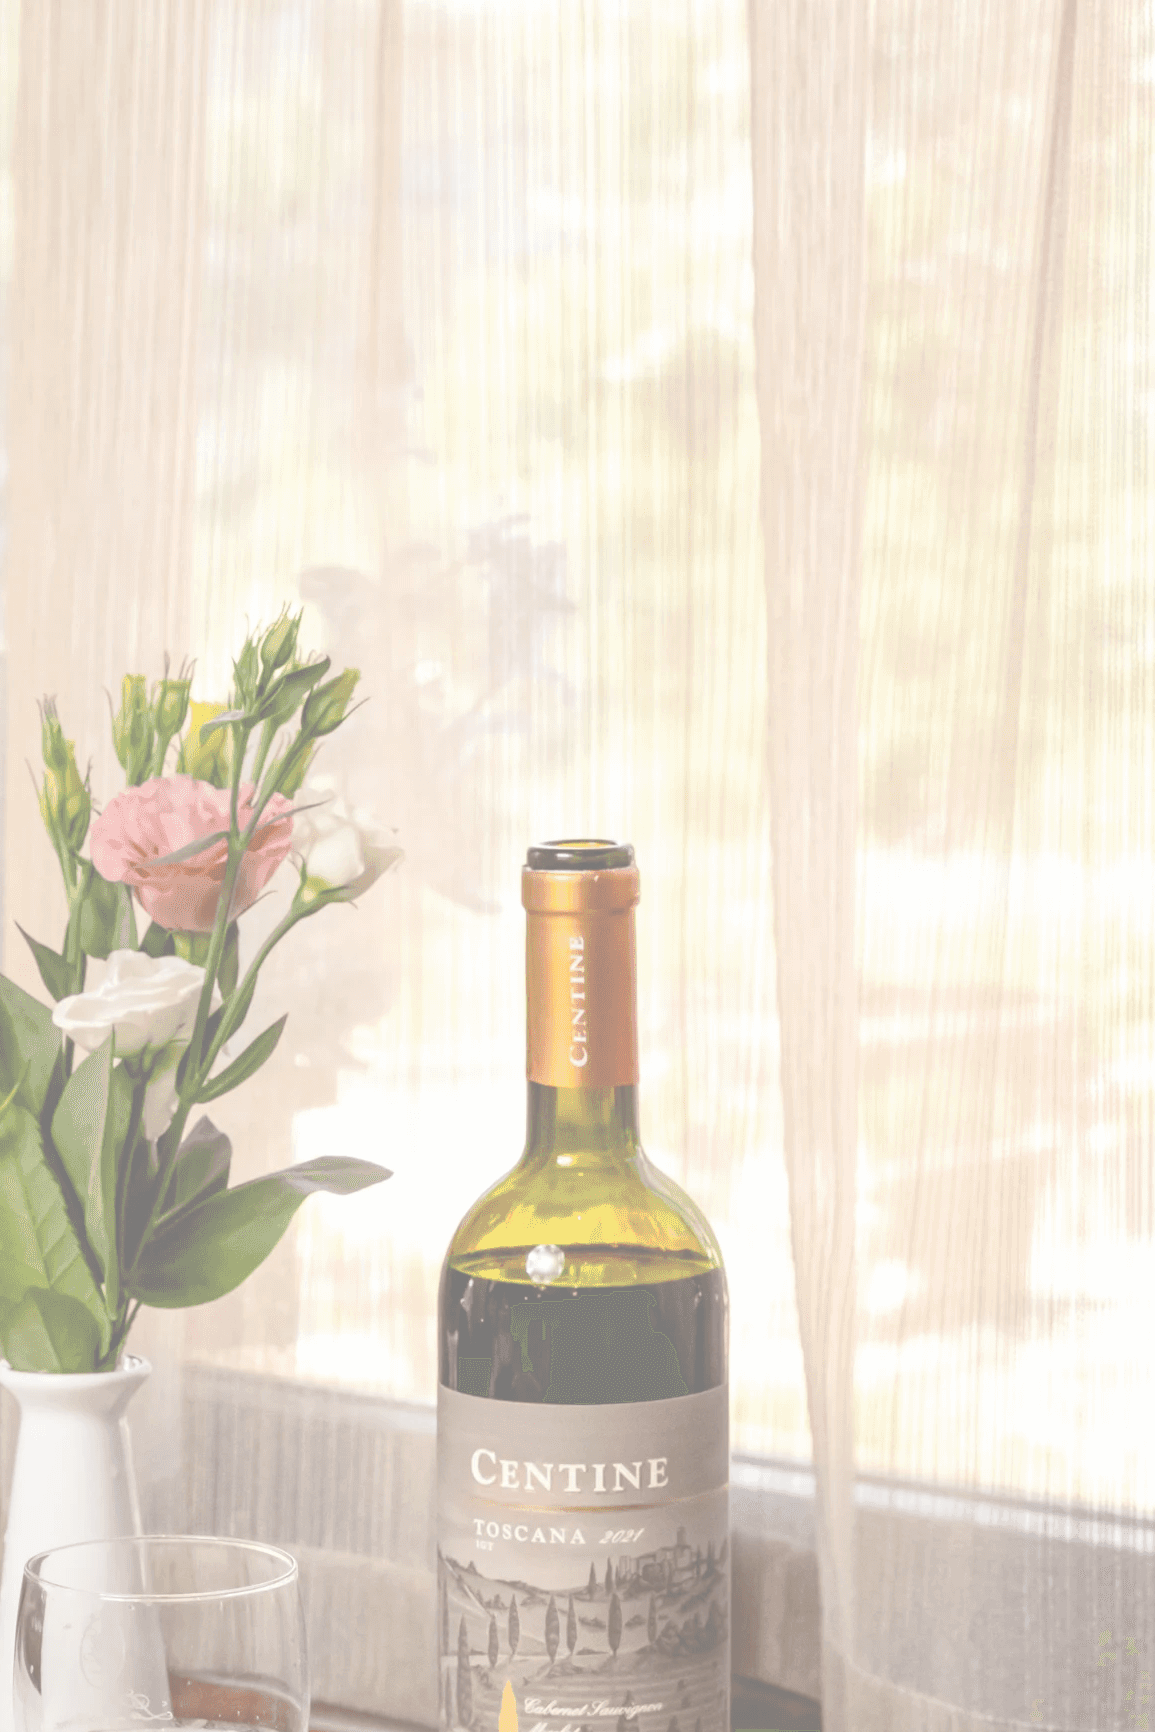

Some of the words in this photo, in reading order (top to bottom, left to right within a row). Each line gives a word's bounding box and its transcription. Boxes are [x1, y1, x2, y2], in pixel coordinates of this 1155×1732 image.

[568, 935, 588, 1068] CENTINE
[471, 1448, 669, 1492] CENTINE
[473, 1519, 586, 1545] TOSCANA
[598, 1527, 645, 1545] 2021
[475, 1540, 495, 1552] IGT
[524, 1697, 588, 1716] Cabernet
[587, 1699, 664, 1720] Sauvignon
